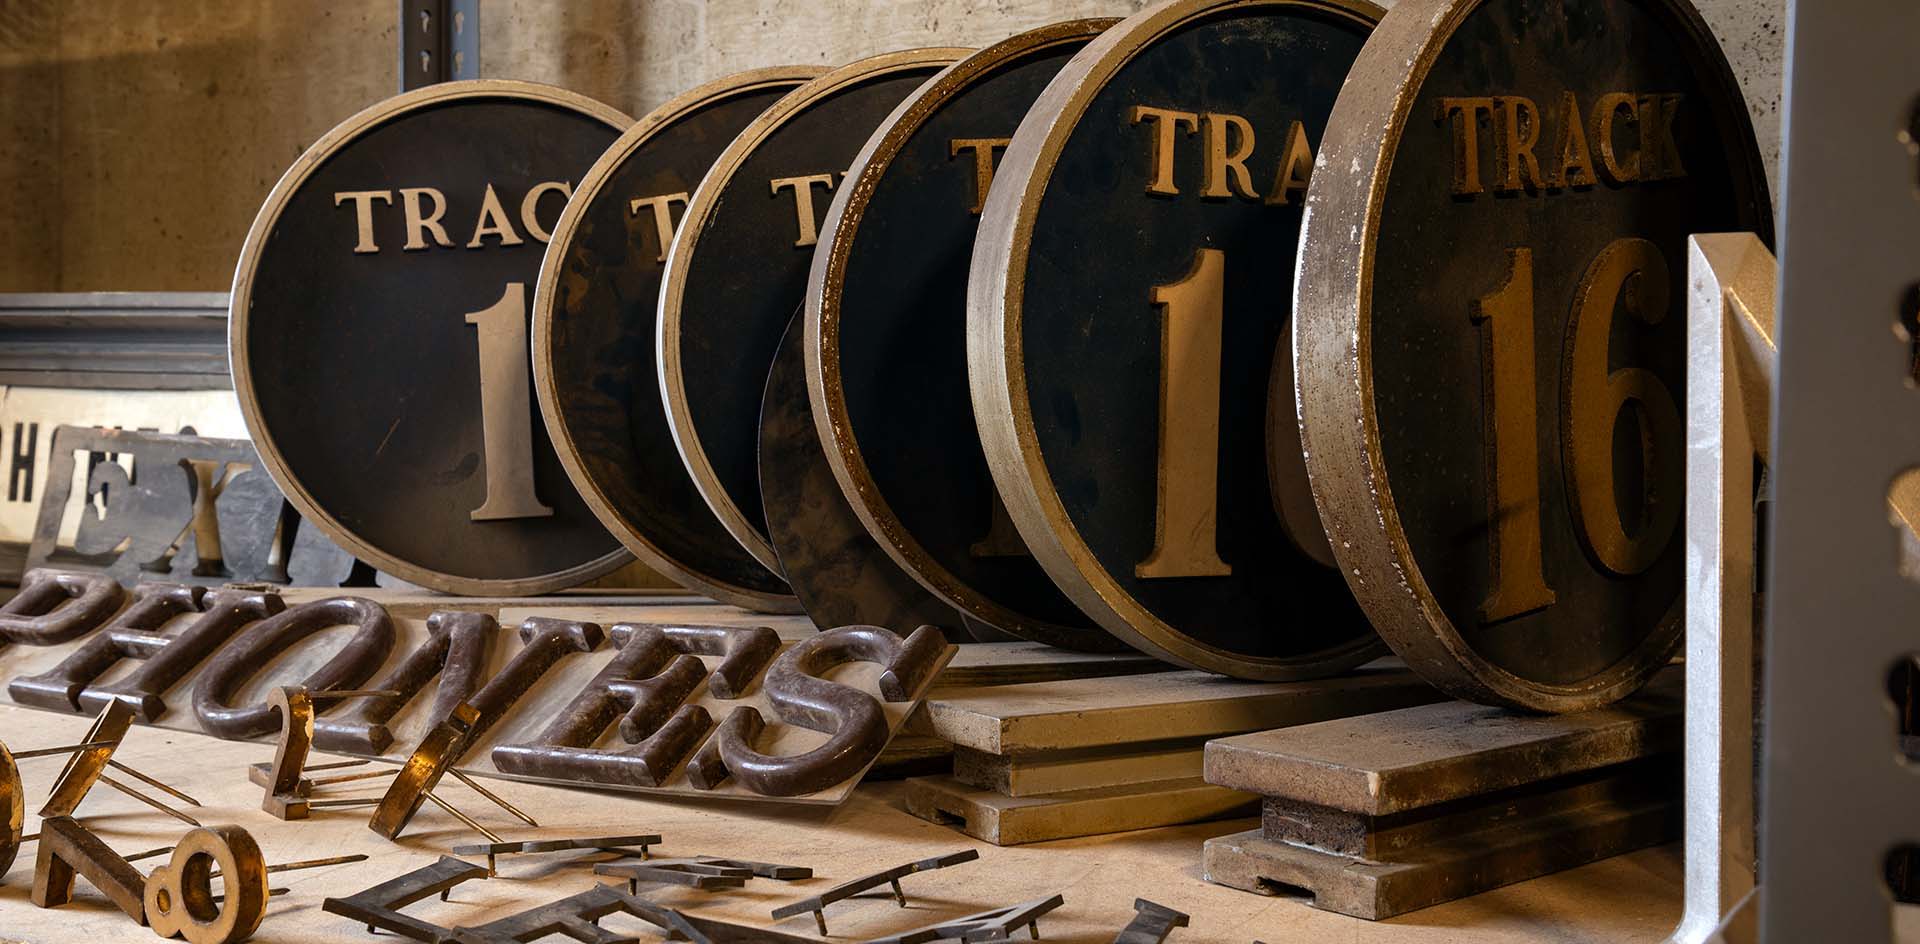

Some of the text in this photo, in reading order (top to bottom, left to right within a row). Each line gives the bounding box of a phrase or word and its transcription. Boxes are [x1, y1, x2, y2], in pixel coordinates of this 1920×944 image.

[1434, 90, 1689, 198] TRACK
[1470, 237, 1687, 630] 16
[0, 568, 948, 798] PHONES
